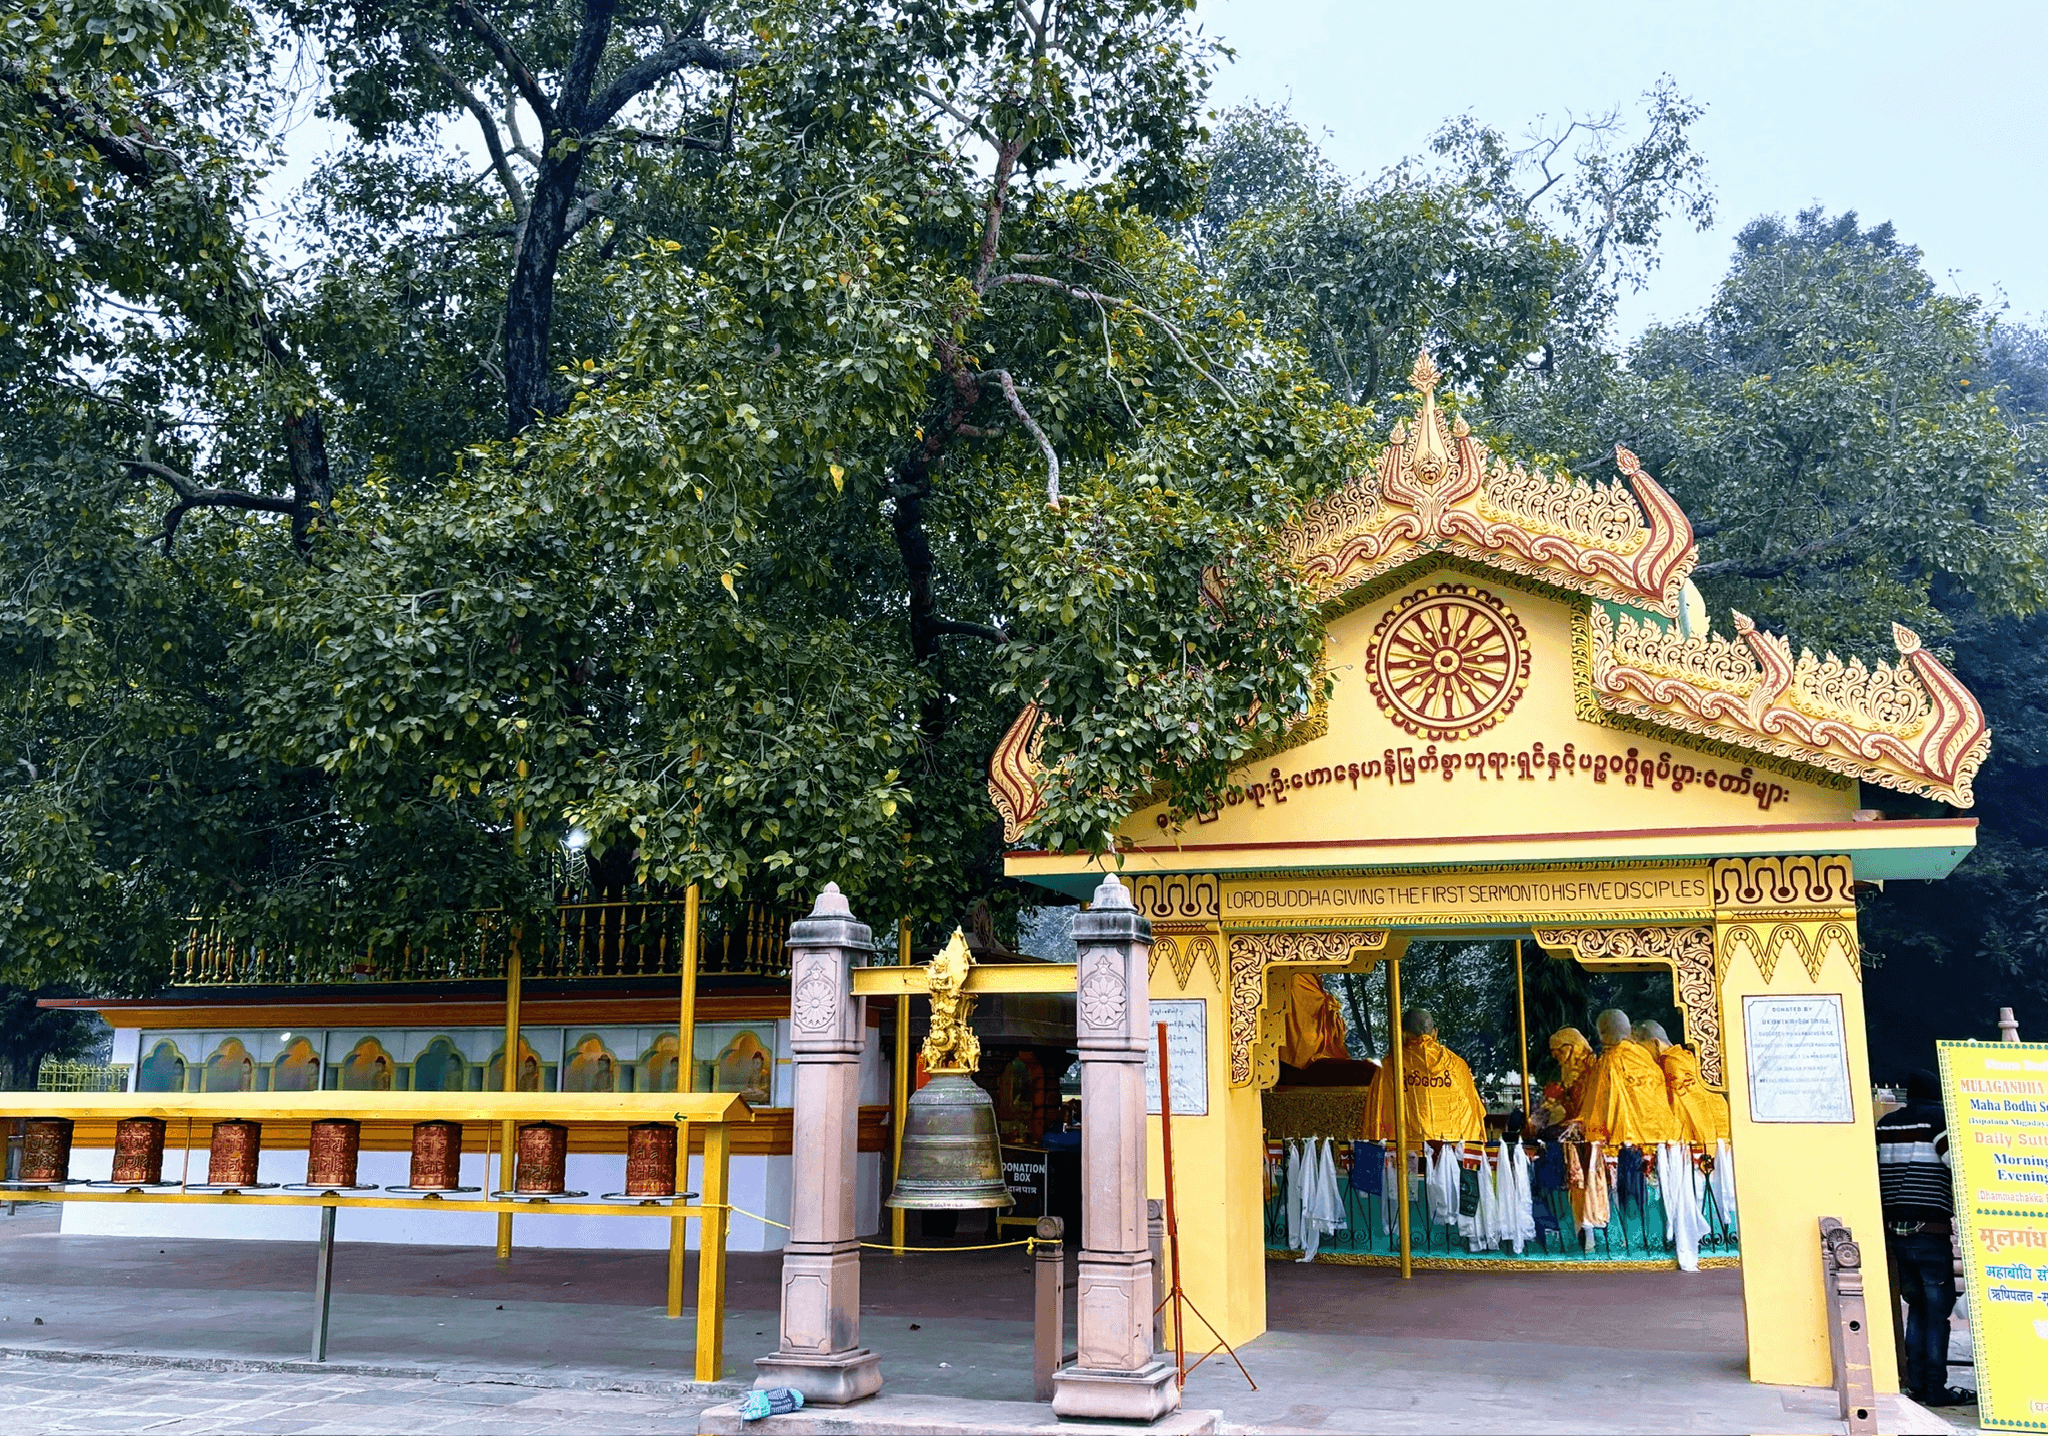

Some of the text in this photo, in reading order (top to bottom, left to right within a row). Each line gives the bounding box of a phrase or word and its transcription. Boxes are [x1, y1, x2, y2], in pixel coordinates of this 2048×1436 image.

[1226, 879, 1705, 909] LORD BUDDHA GIVING THE FIRST SERMON TO HIS FIVE DISCIPLES
[1960, 1079, 2045, 1095] MULAGANDHA
[1969, 1099, 2001, 1111] Maha
[2003, 1100, 2037, 1112] Bodhi
[1975, 1131, 2012, 1149] Daily
[1002, 1163, 1045, 1173] DONATION
[1014, 1173, 1031, 1182] BOX
[1984, 1263, 2033, 1280] महाबोधि
